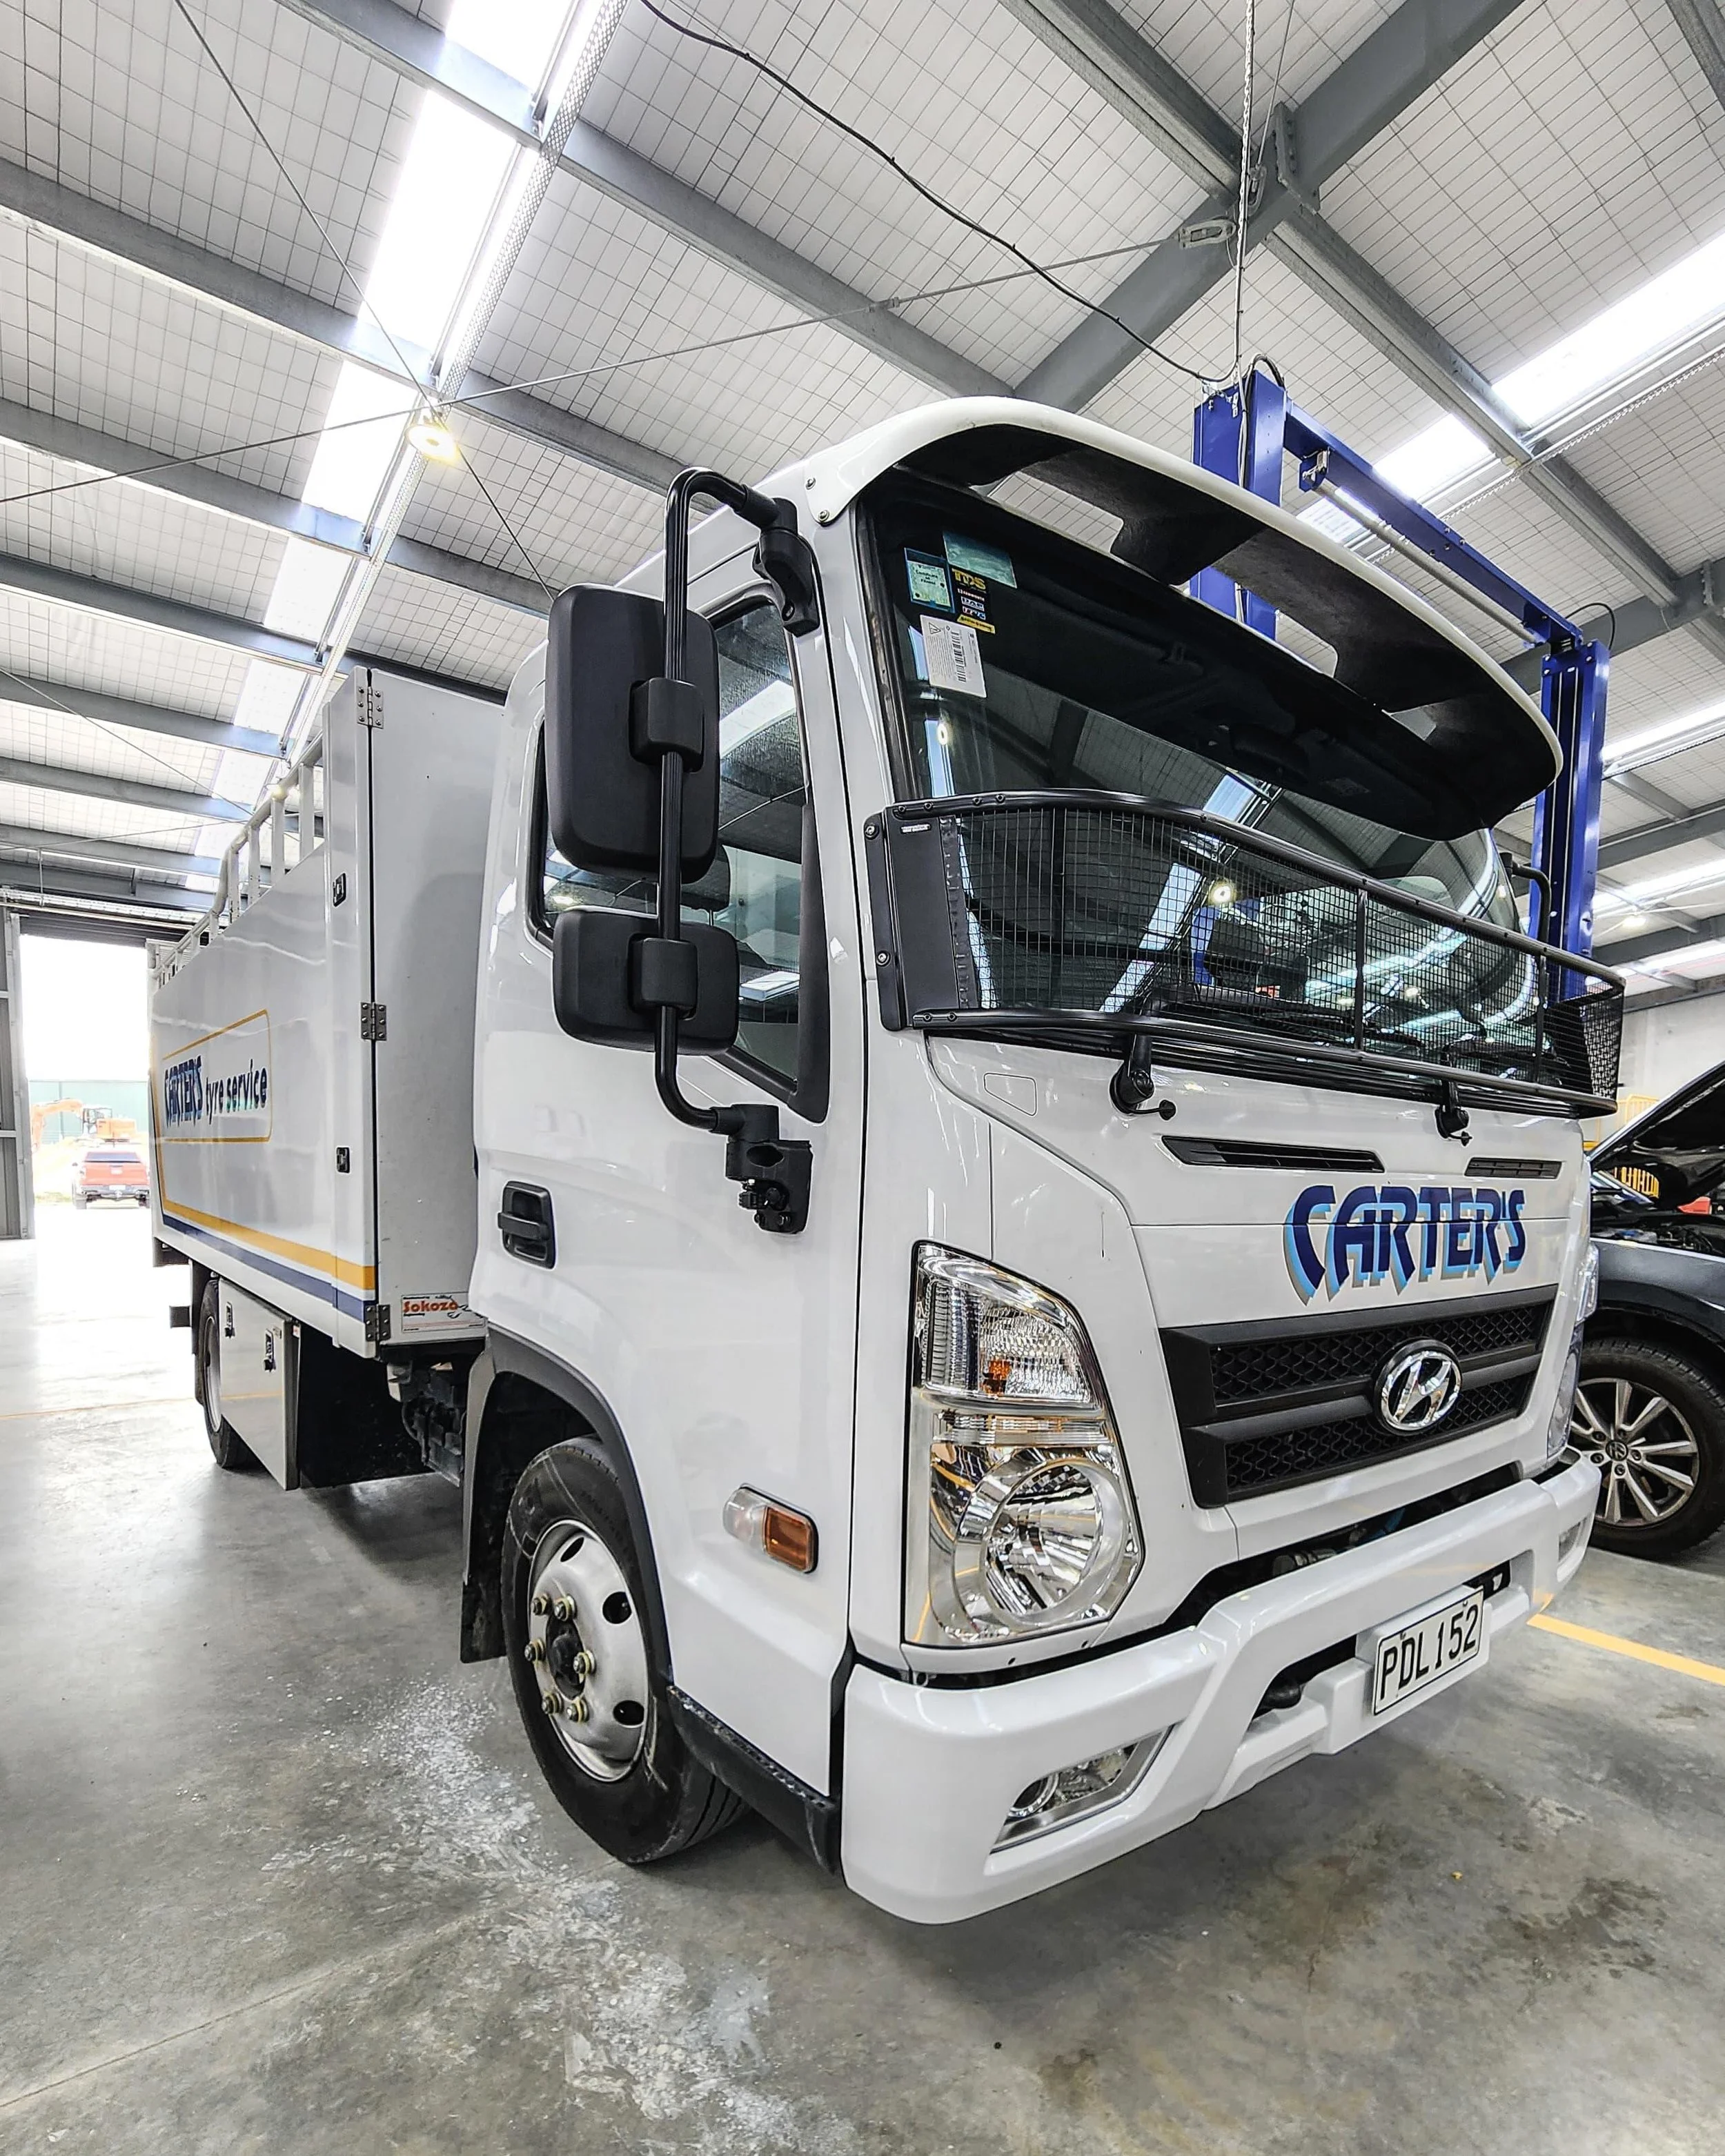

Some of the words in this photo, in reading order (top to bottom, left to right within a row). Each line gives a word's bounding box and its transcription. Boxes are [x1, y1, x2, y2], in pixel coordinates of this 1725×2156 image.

[206, 1076, 224, 1126] tyre
[226, 1058, 268, 1113] service
[1284, 1185, 1526, 1305] CARTER'S
